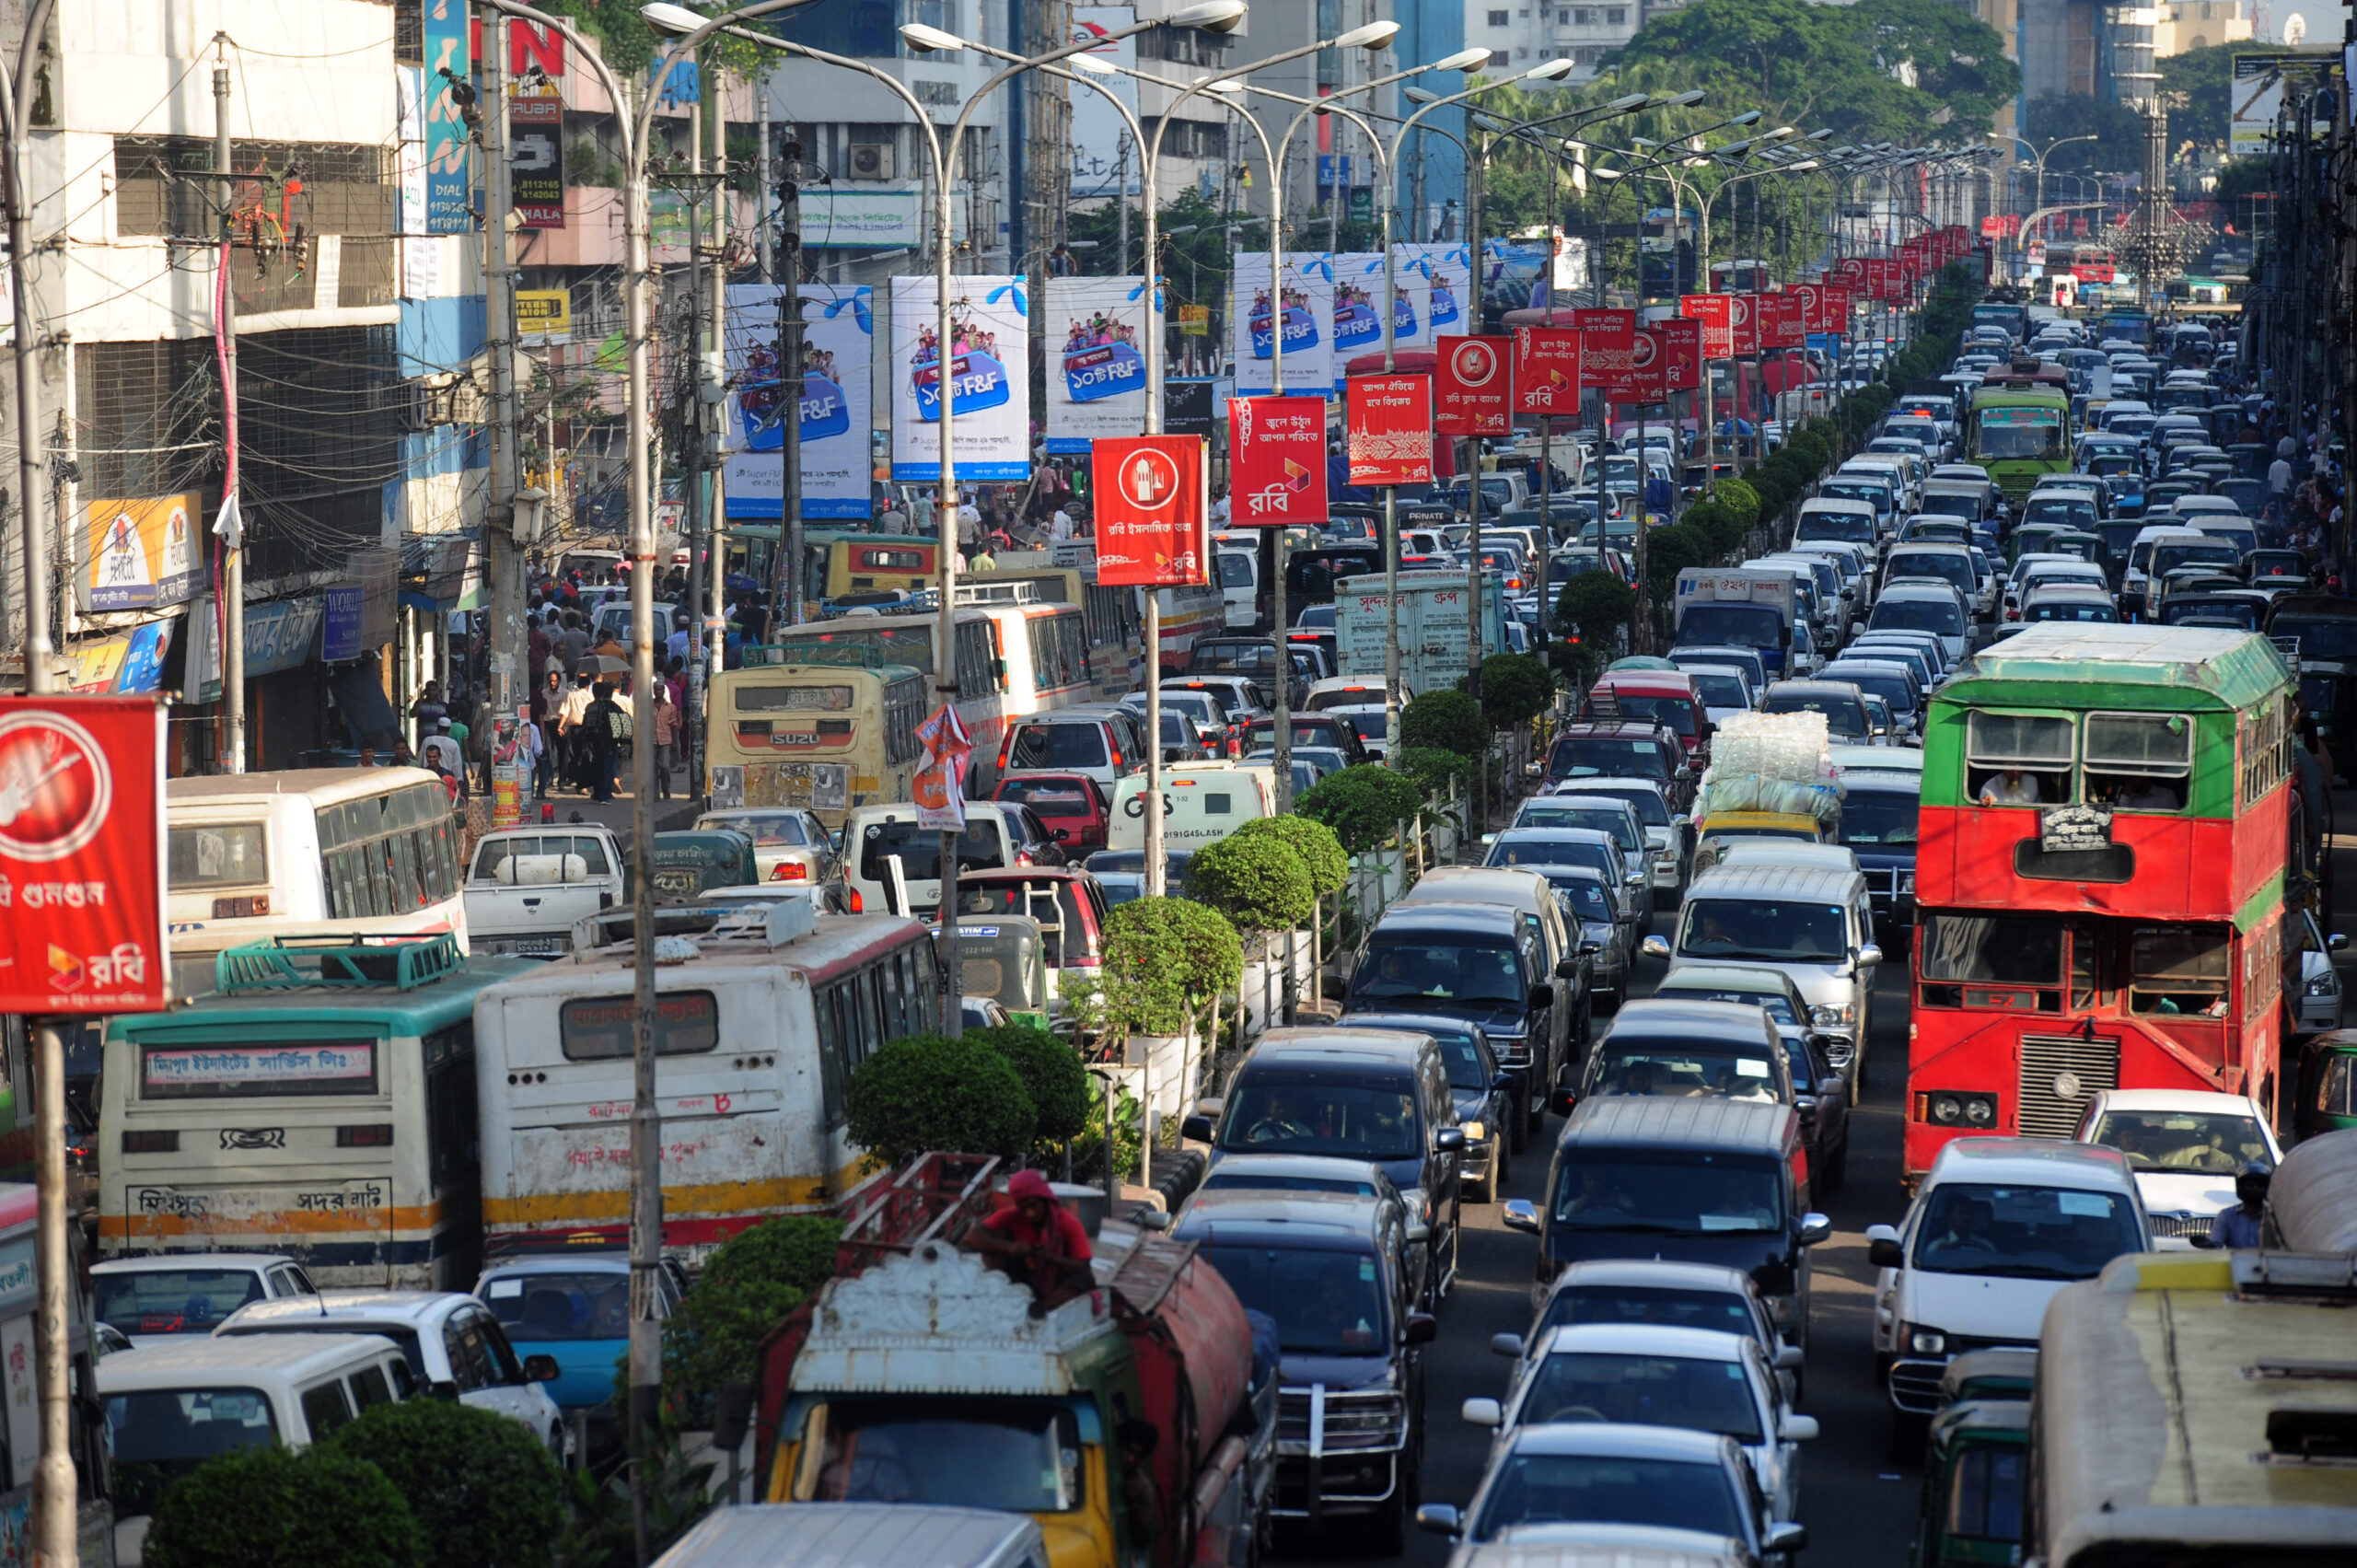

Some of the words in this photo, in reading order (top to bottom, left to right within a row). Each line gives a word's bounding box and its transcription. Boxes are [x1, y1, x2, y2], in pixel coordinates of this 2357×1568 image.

[435, 184, 461, 196] DIAL
[1432, 301, 1451, 316] F&F
[1351, 319, 1374, 335] F&F
[1395, 315, 1411, 328] &F
[1286, 323, 1312, 343] F&F
[1071, 367, 1107, 389] ১০টি
[1107, 360, 1136, 381] F&F
[1667, 366, 1680, 382] বি
[963, 371, 998, 396] F&F
[1363, 383, 1385, 392] আপন
[1446, 393, 1459, 404] রবি
[1525, 386, 1552, 407] রবি
[1650, 388, 1663, 398] রবি
[799, 396, 837, 424] F&F
[1366, 398, 1380, 407] হবে
[1266, 417, 1287, 428] জ্বলে
[1290, 413, 1311, 429] উঠুন
[1487, 413, 1504, 427] রবি
[1260, 434, 1285, 443] আপন
[1288, 430, 1318, 442] শক্তিতে
[747, 470, 767, 479] Super
[1412, 465, 1428, 479] রবি
[1248, 482, 1289, 517] রবি
[1409, 512, 1445, 520] PRIVATE
[1108, 522, 1125, 536] রবি
[1128, 520, 1171, 535] ইসলামিক
[1174, 551, 1196, 572] রবি
[1720, 579, 1747, 592] ঔষধ
[1360, 595, 1405, 613] সুন্দরন
[1434, 592, 1457, 605] গ্রুপ
[770, 734, 820, 744] ISUZU
[1124, 793, 1174, 819] GS
[22, 881, 106, 909] গুনগুন
[87, 942, 145, 989] রবি
[192, 1054, 250, 1071] ইউনাইটেড
[258, 1051, 310, 1070] সার্ভিস
[318, 1050, 346, 1069] লিঃ
